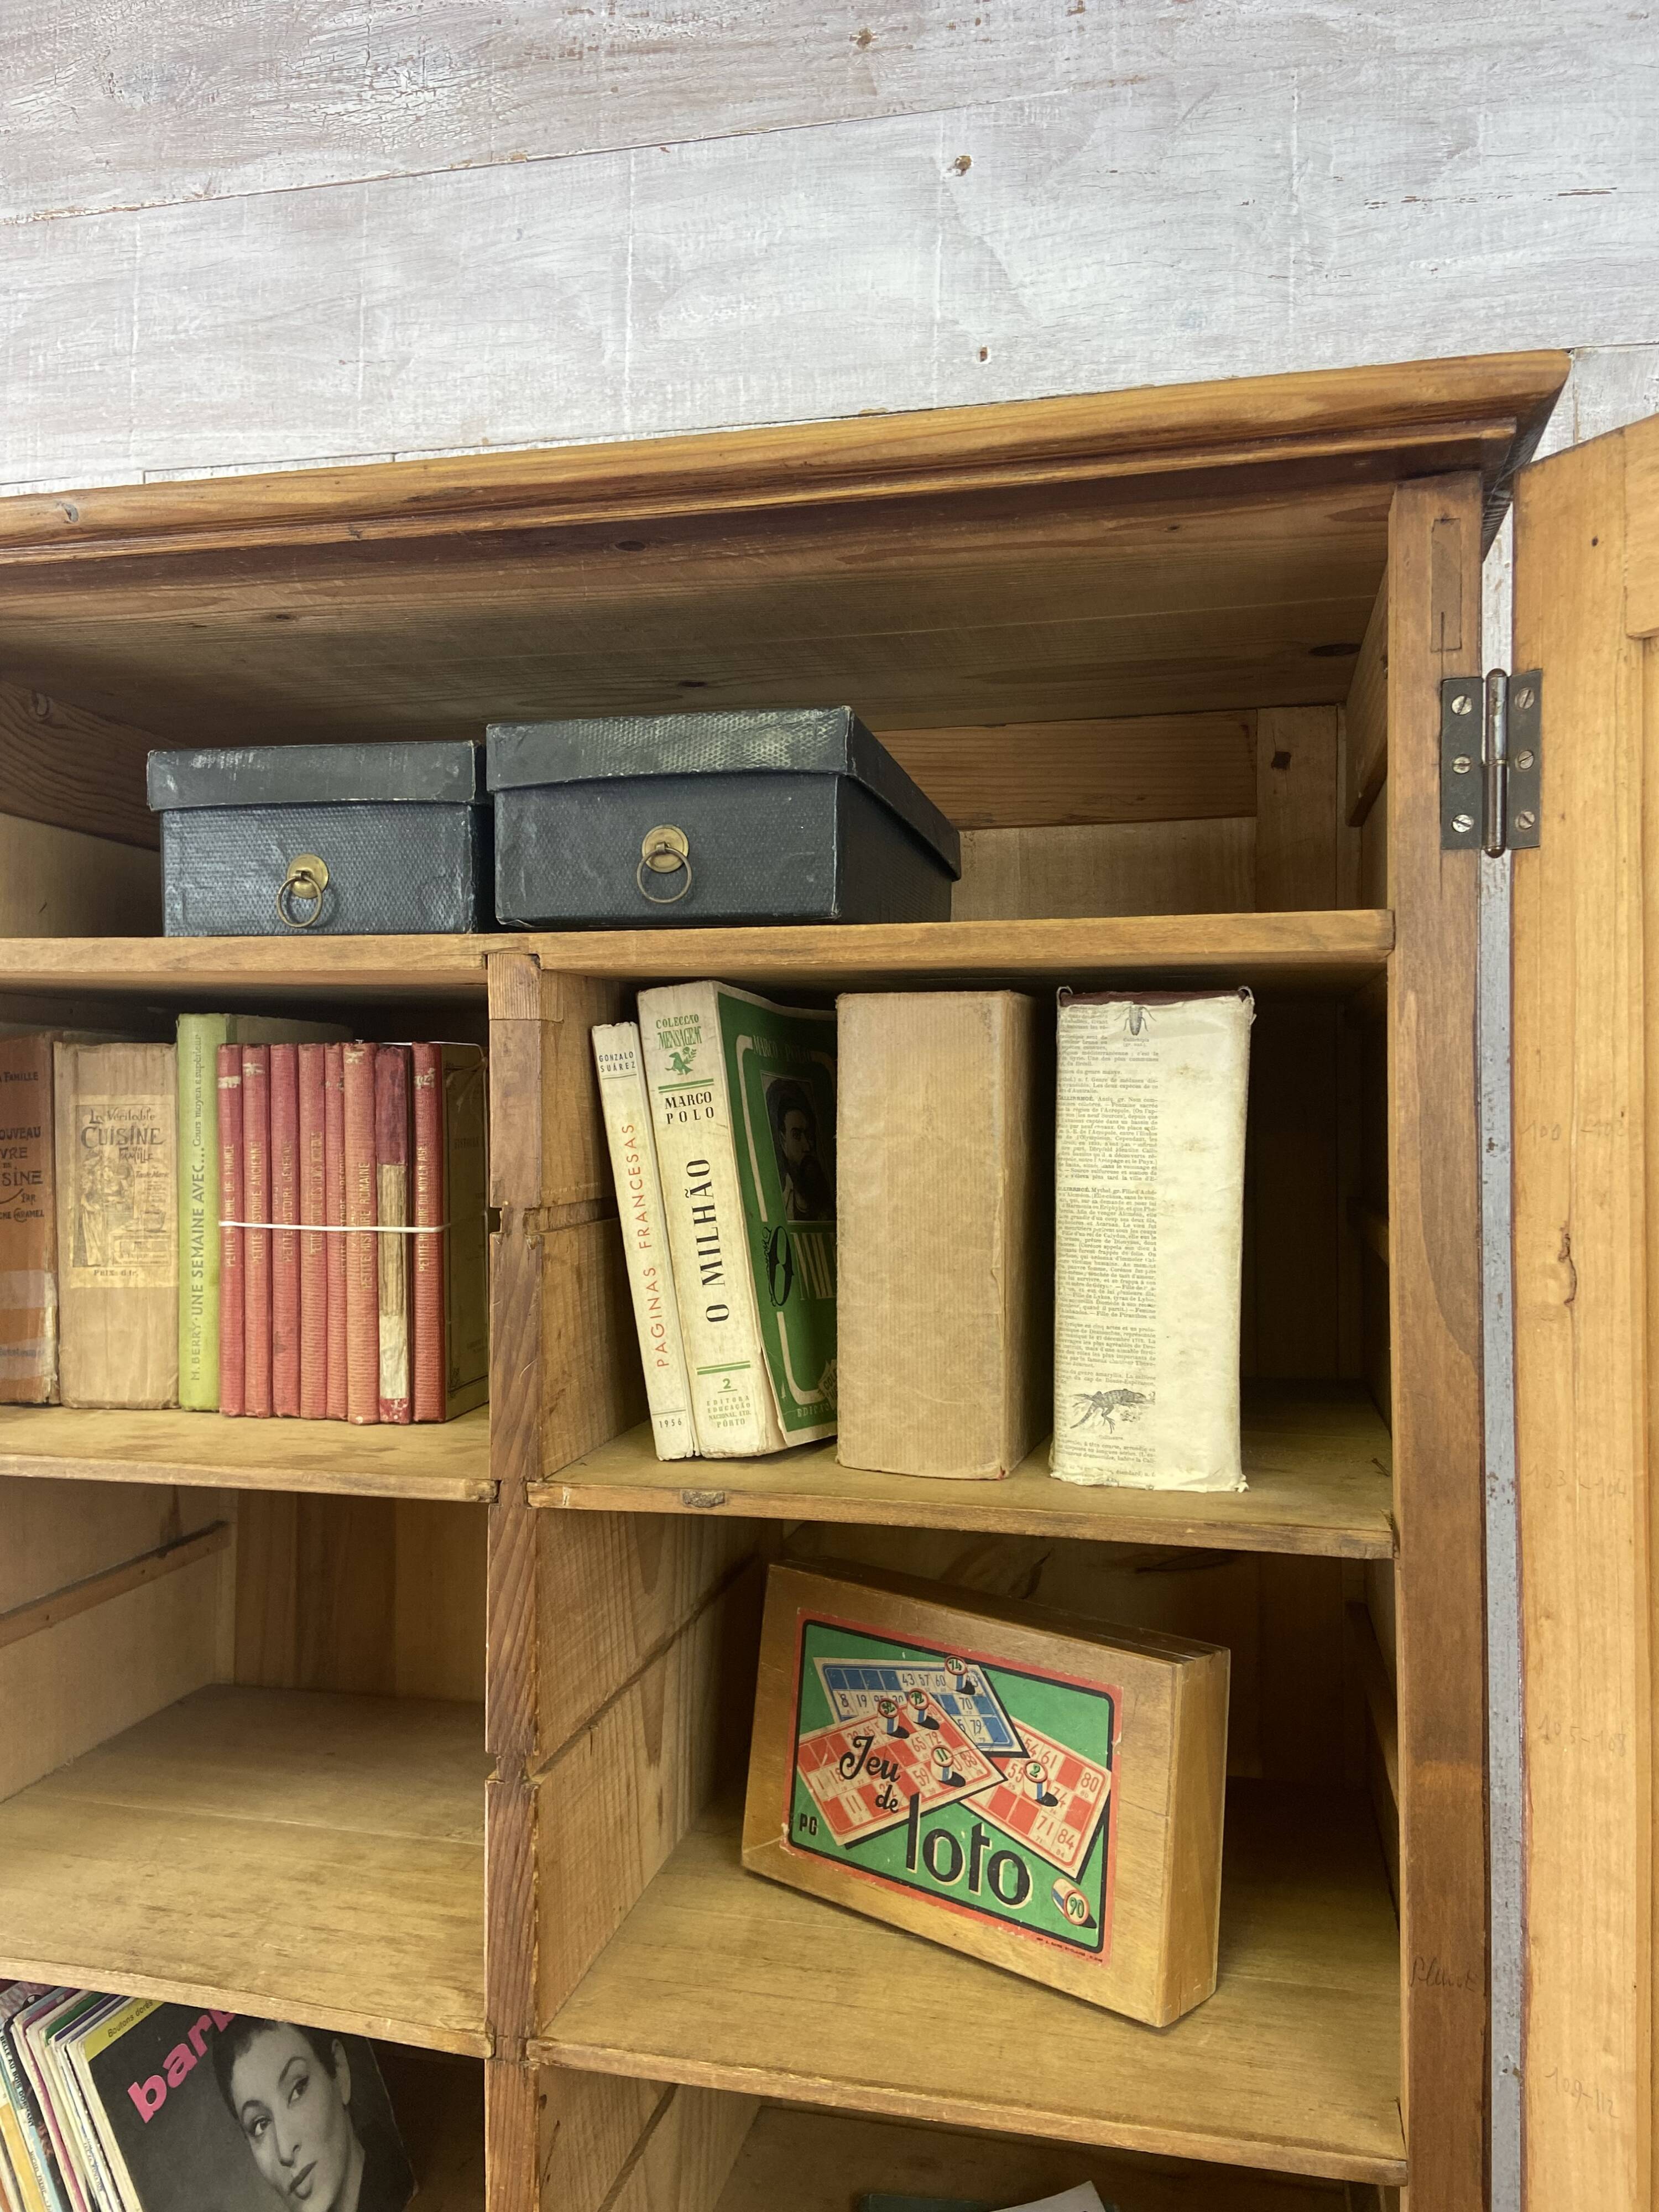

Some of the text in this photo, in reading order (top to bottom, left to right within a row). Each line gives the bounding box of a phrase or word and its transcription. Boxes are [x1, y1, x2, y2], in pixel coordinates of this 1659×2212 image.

[599, 1051, 633, 1062] GONZALO
[601, 1061, 636, 1073] SUÁREZ
[4, 1072, 39, 1082] FAMILLE
[194, 1087, 204, 1118] moyen
[665, 1092, 712, 1109] MARCO
[666, 1107, 714, 1124] POLO
[192, 1121, 201, 1146] Cours
[224, 1144, 234, 1175] FRANCE
[251, 1141, 262, 1186] ANCIENNE
[225, 1181, 234, 1192] DE
[358, 1161, 371, 1204] ROMAINE
[418, 1165, 428, 1192] MOYEN
[418, 1194, 428, 1204] DU
[191, 1208, 204, 1279] SEMAINE
[225, 1238, 236, 1267] PETITE
[252, 1233, 263, 1265] PETITE
[283, 1231, 293, 1262] PETITE
[622, 1124, 670, 1368] PAGINAS FRANCESAS
[685, 1159, 729, 1323] O MILHÃO
[418, 1243, 429, 1272] PETITE
[360, 1255, 372, 1289] PETITE
[191, 1285, 204, 1316] UNE
[190, 1322, 201, 1364] BERRY
[722, 1378, 732, 1389] 2
[707, 1395, 749, 1406] EDITORA
[707, 1403, 750, 1413] EDUCAÇÃO
[659, 1418, 682, 1429] 1956
[902, 1673, 946, 1687] 43 57 60
[840, 1694, 973, 1710] 8 19 70
[970, 1719, 982, 1735] 79
[911, 1736, 927, 1752] 65
[839, 1734, 901, 1783] Jeu
[1041, 1750, 1057, 1769] 61
[1080, 1771, 1099, 1793] 80
[912, 1767, 930, 1787] 59
[875, 1784, 900, 1814] de
[799, 1813, 817, 1835] PG
[1037, 1815, 1074, 1850] 71 84
[906, 1791, 1033, 1908] loto
[1069, 1896, 1085, 1919] 90
[107, 2013, 134, 2038] Boutons
